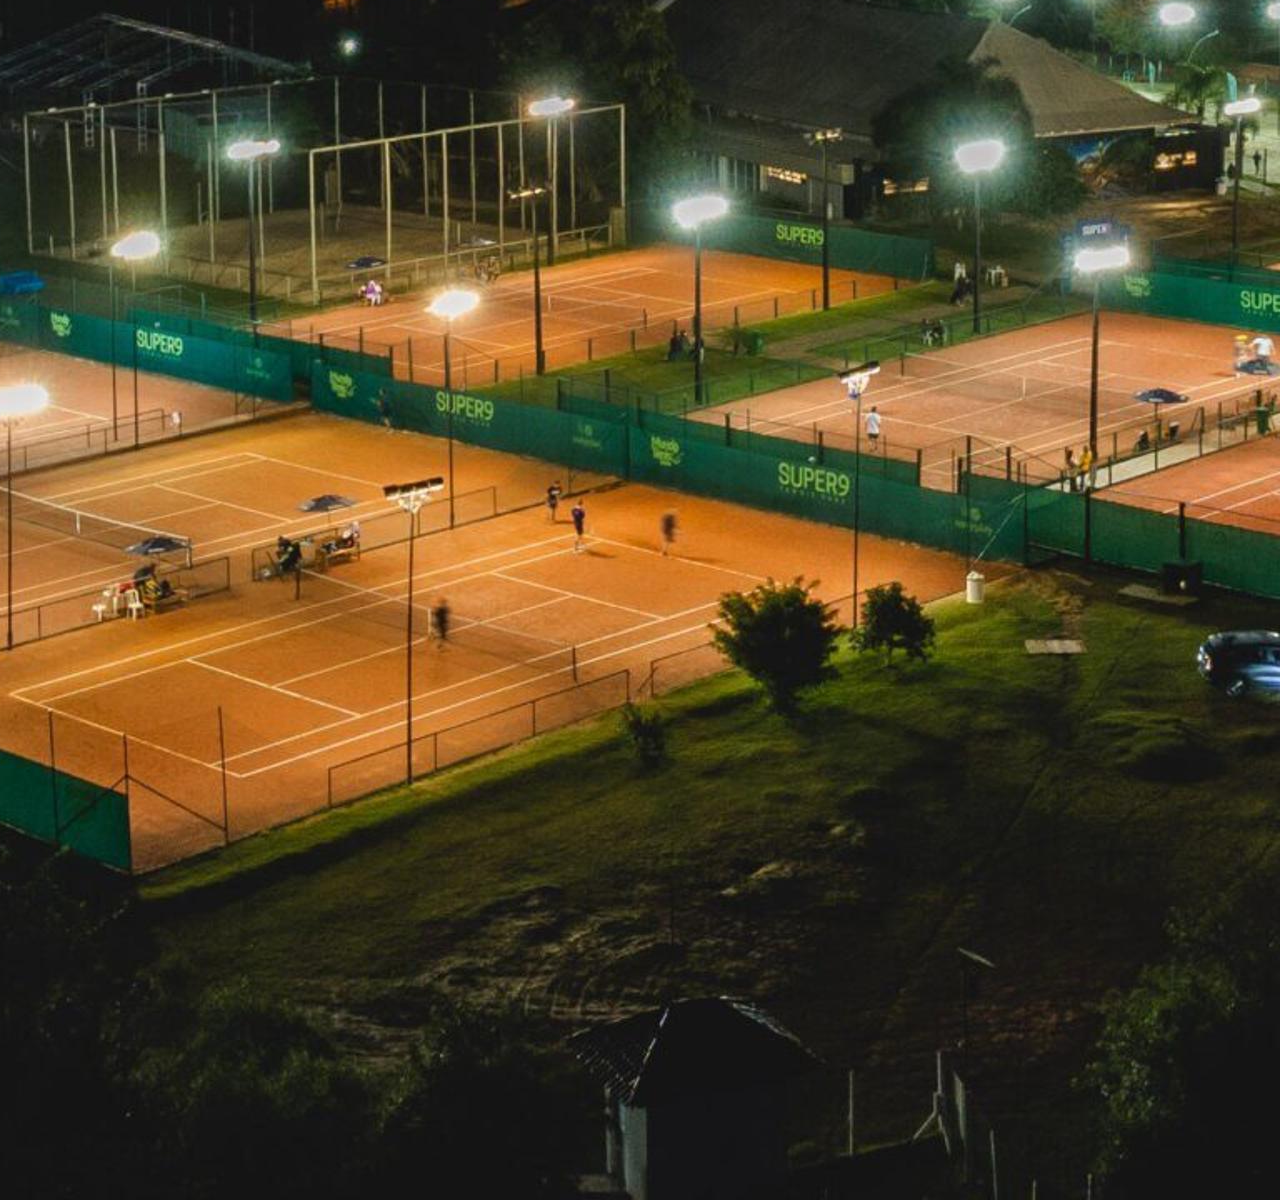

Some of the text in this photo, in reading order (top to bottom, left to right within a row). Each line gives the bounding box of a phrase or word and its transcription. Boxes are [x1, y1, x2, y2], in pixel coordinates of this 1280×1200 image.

[775, 224, 825, 246] SUPER9
[136, 328, 183, 357] SUPER9
[436, 390, 495, 422] SUPER9
[778, 461, 851, 498] SUPER9
